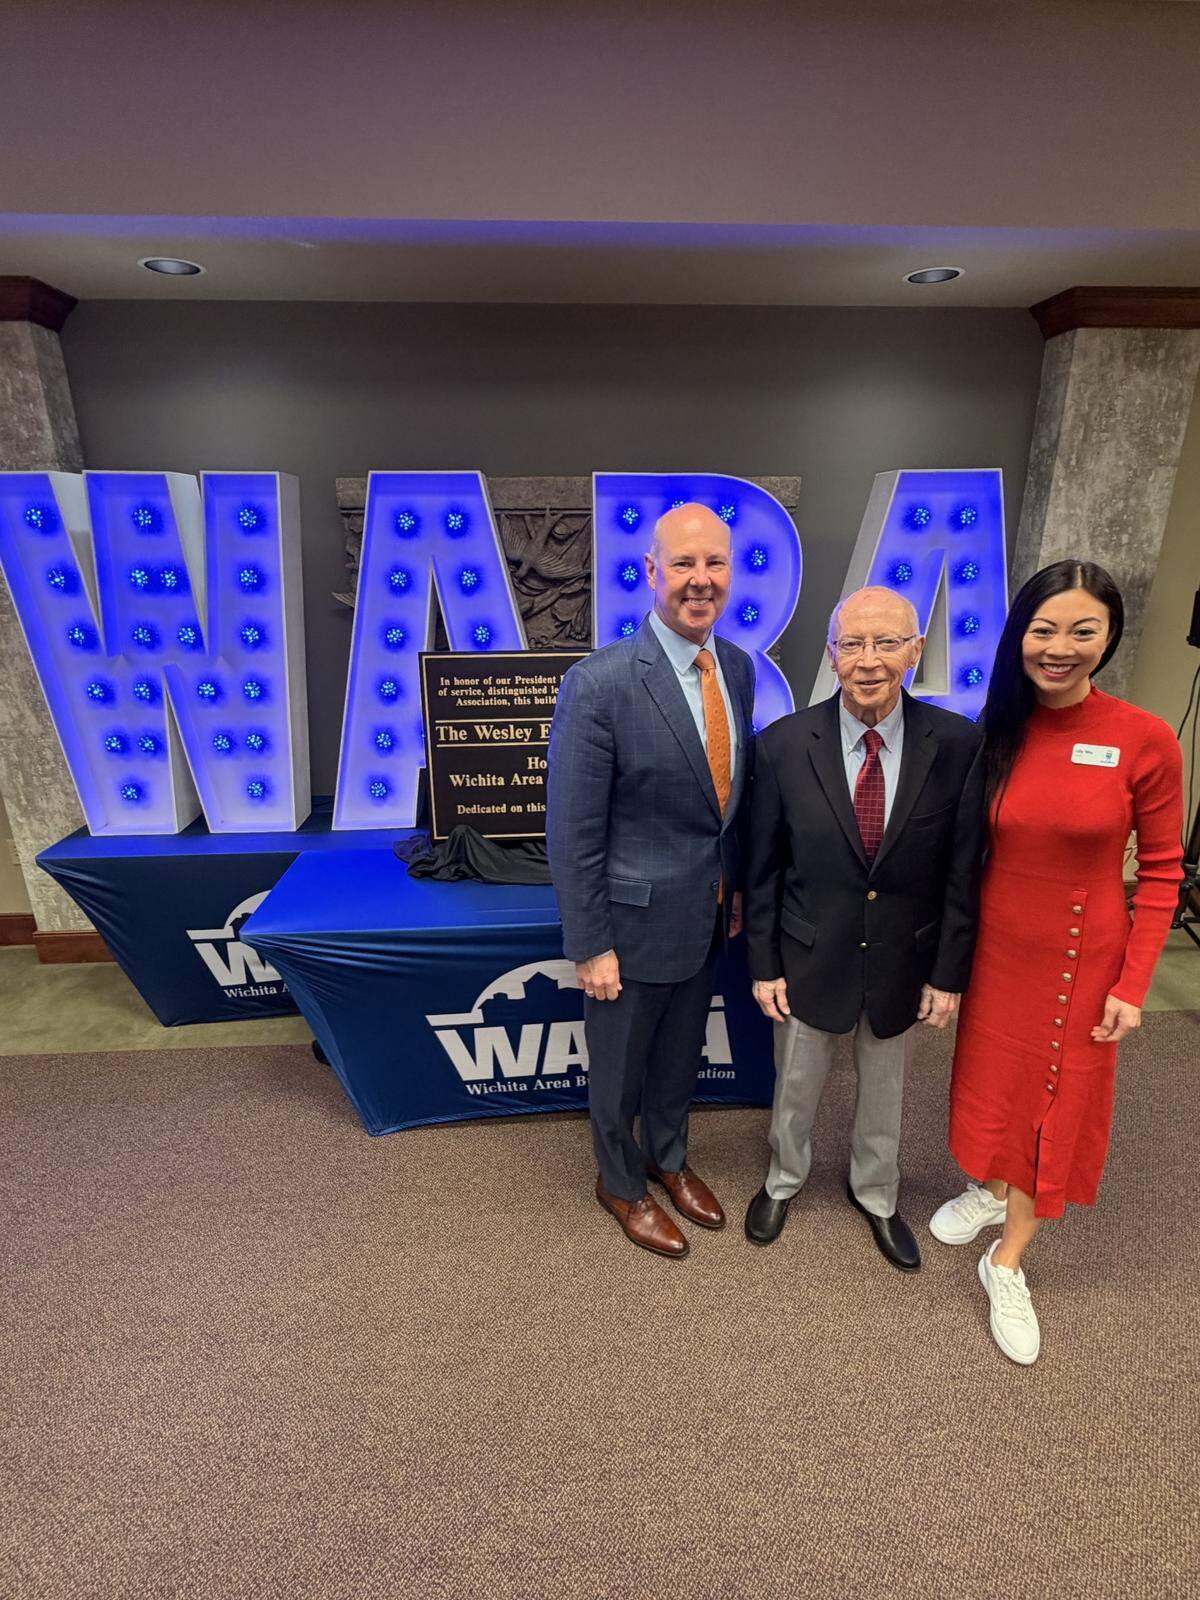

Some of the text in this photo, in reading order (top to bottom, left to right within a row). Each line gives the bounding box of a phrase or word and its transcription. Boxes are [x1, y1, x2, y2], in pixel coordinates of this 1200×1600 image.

[440, 677, 451, 686] In
[453, 677, 480, 685] honor
[483, 676, 493, 685] of
[514, 675, 557, 685] President
[438, 687, 448, 696] of
[451, 687, 485, 697] service,
[487, 685, 547, 697] distinguished
[456, 696, 511, 707] Association,
[514, 695, 531, 705] this
[435, 725, 468, 741] The
[474, 724, 533, 742] Wesley
[527, 756, 548, 770] Ho
[449, 772, 544, 788] Wichita Area
[457, 802, 547, 815] Dedicated on this
[223, 984, 277, 999] Wichita
[465, 1081, 528, 1096] Wichita
[534, 1077, 571, 1092] Area
